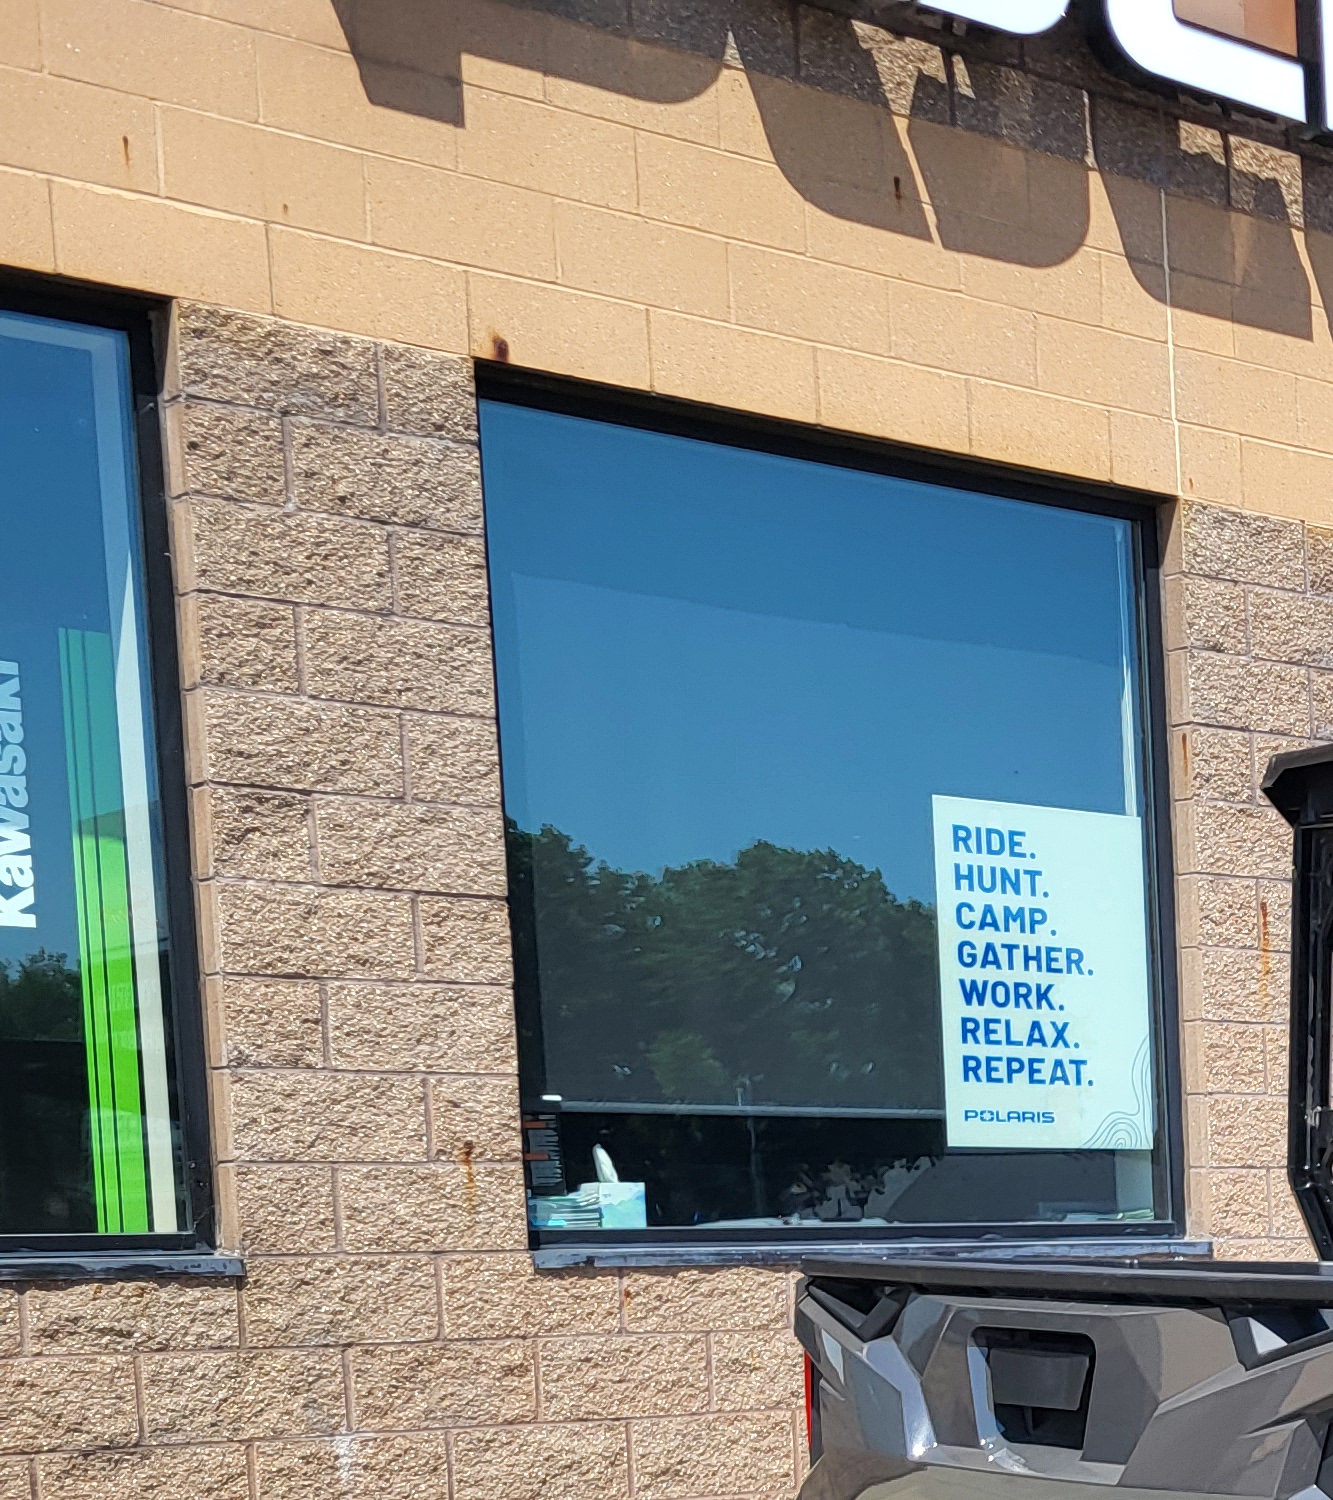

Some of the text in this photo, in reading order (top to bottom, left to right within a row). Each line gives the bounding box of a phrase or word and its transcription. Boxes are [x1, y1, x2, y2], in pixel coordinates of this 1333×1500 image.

[953, 824, 1036, 859] RIDE.
[953, 863, 1049, 898] HUNT.
[956, 902, 1057, 936] CAMP.
[957, 941, 1094, 976] GATHER.
[958, 978, 1064, 1012] WORK.
[961, 1017, 1080, 1049] RELAX.
[962, 1055, 1094, 1086] REPEAT.
[964, 1109, 1055, 1123] POLARIS
